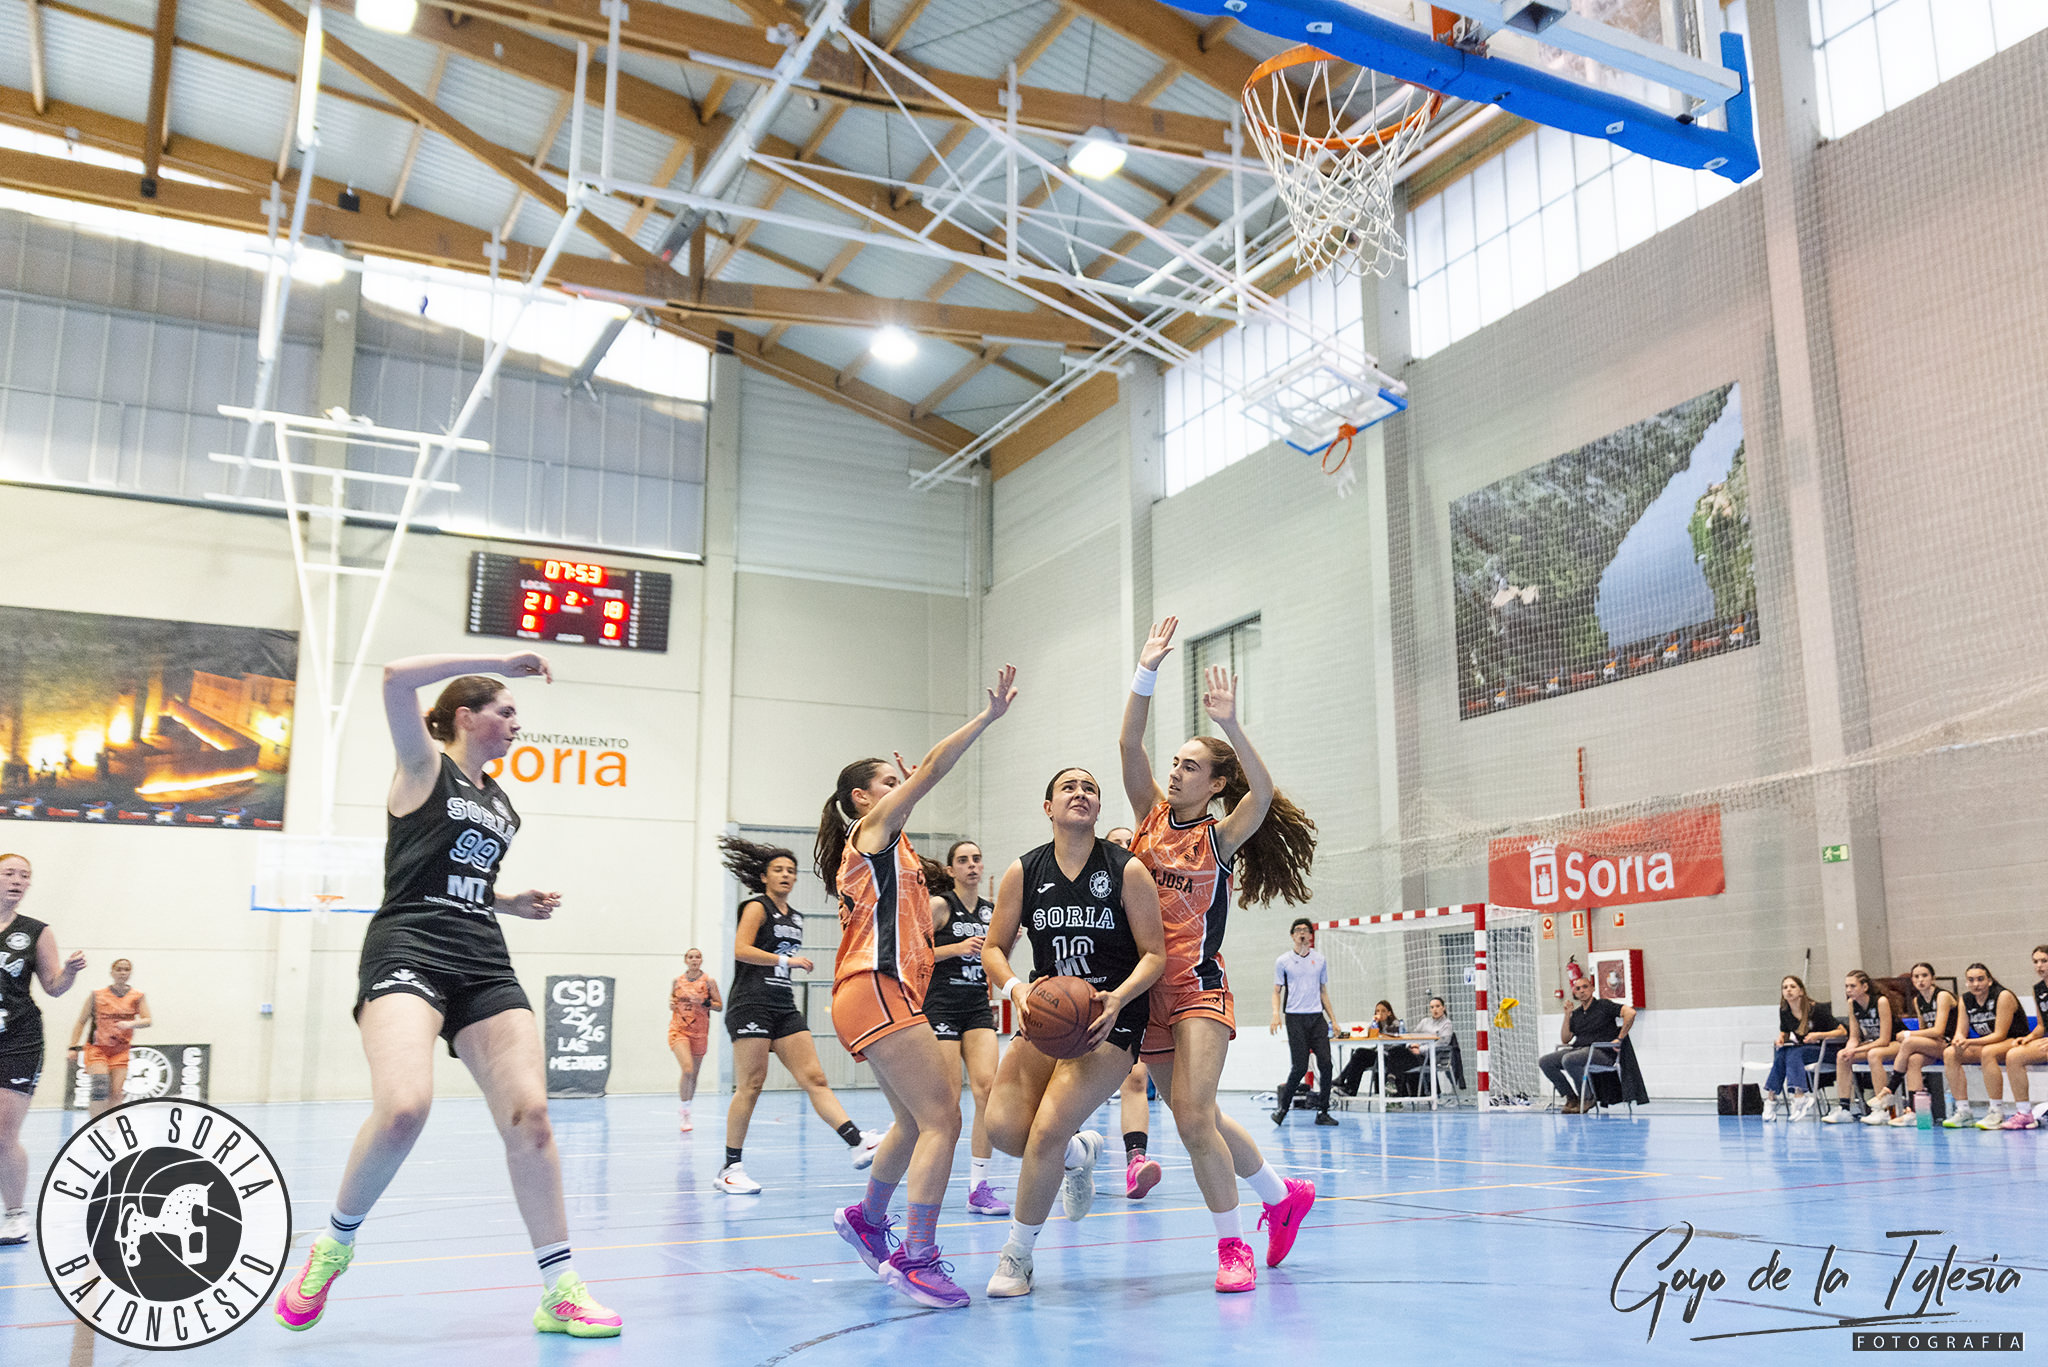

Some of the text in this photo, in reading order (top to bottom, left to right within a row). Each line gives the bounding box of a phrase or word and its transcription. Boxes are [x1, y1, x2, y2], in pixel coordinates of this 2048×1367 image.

[544, 560, 602, 585] 07:53
[523, 591, 552, 610] 21
[603, 601, 624, 620] 18
[513, 732, 629, 749] AYUNTAMIENTO
[449, 828, 500, 873] 99
[1151, 869, 1193, 893] AJOSA
[1564, 852, 1675, 900] Soria
[447, 874, 488, 904] MT
[1033, 905, 1115, 931] SORIA
[1055, 955, 1092, 977] MT
[552, 980, 605, 1007] CSB
[557, 1036, 590, 1053] LAS
